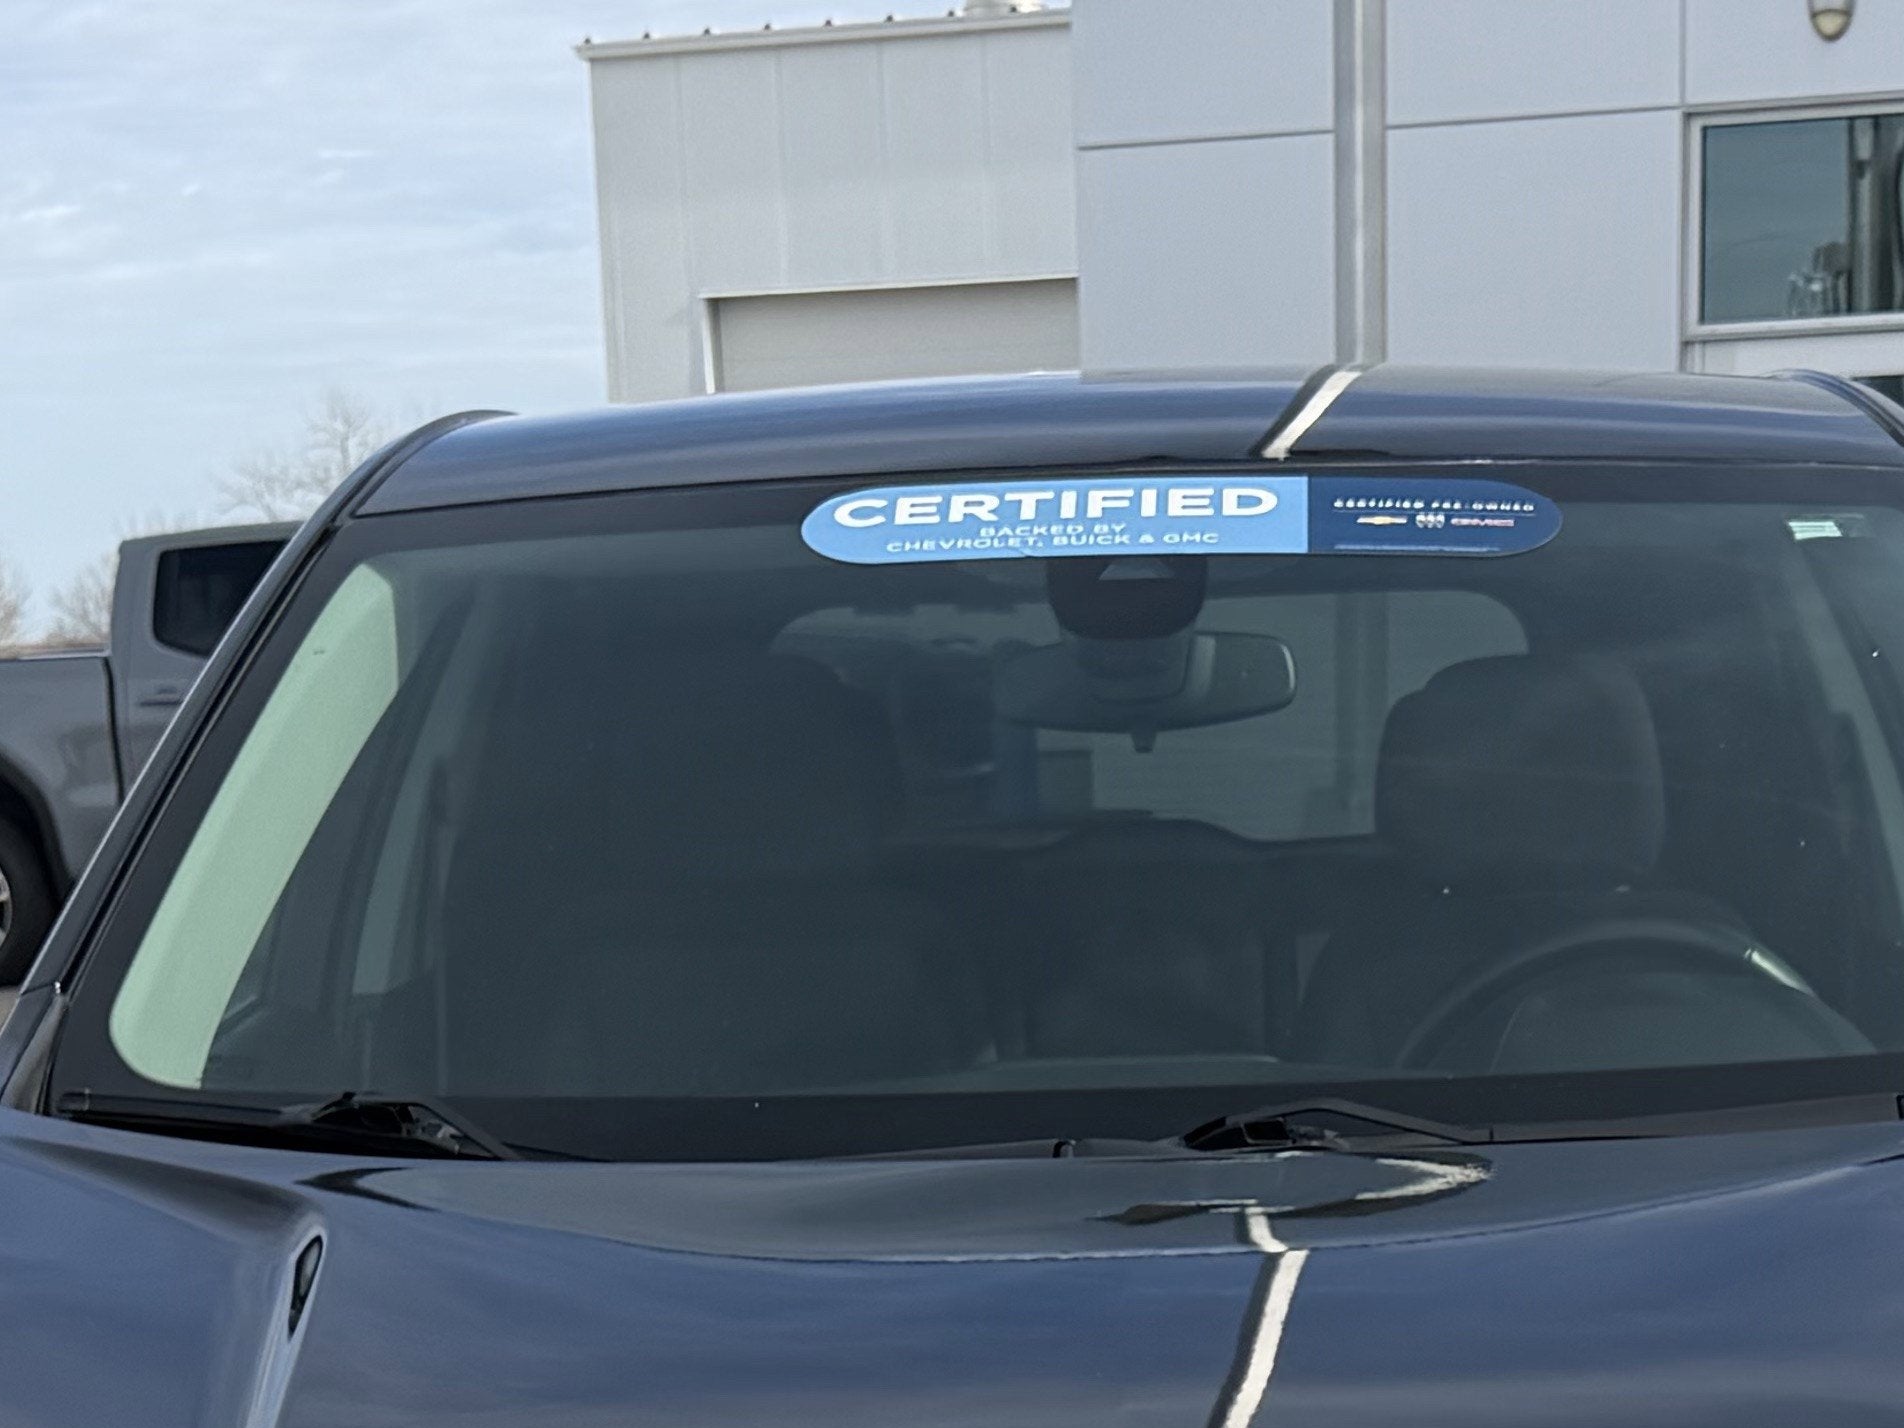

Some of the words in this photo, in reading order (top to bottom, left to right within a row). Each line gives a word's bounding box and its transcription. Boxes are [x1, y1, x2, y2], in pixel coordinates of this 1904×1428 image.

[833, 486, 1279, 528] CERTIFIED
[980, 523, 1085, 539] BACKED
[1093, 521, 1127, 536] BY
[1052, 533, 1131, 546] BUICK
[1138, 533, 1156, 544] &
[1163, 532, 1221, 544] GMC
